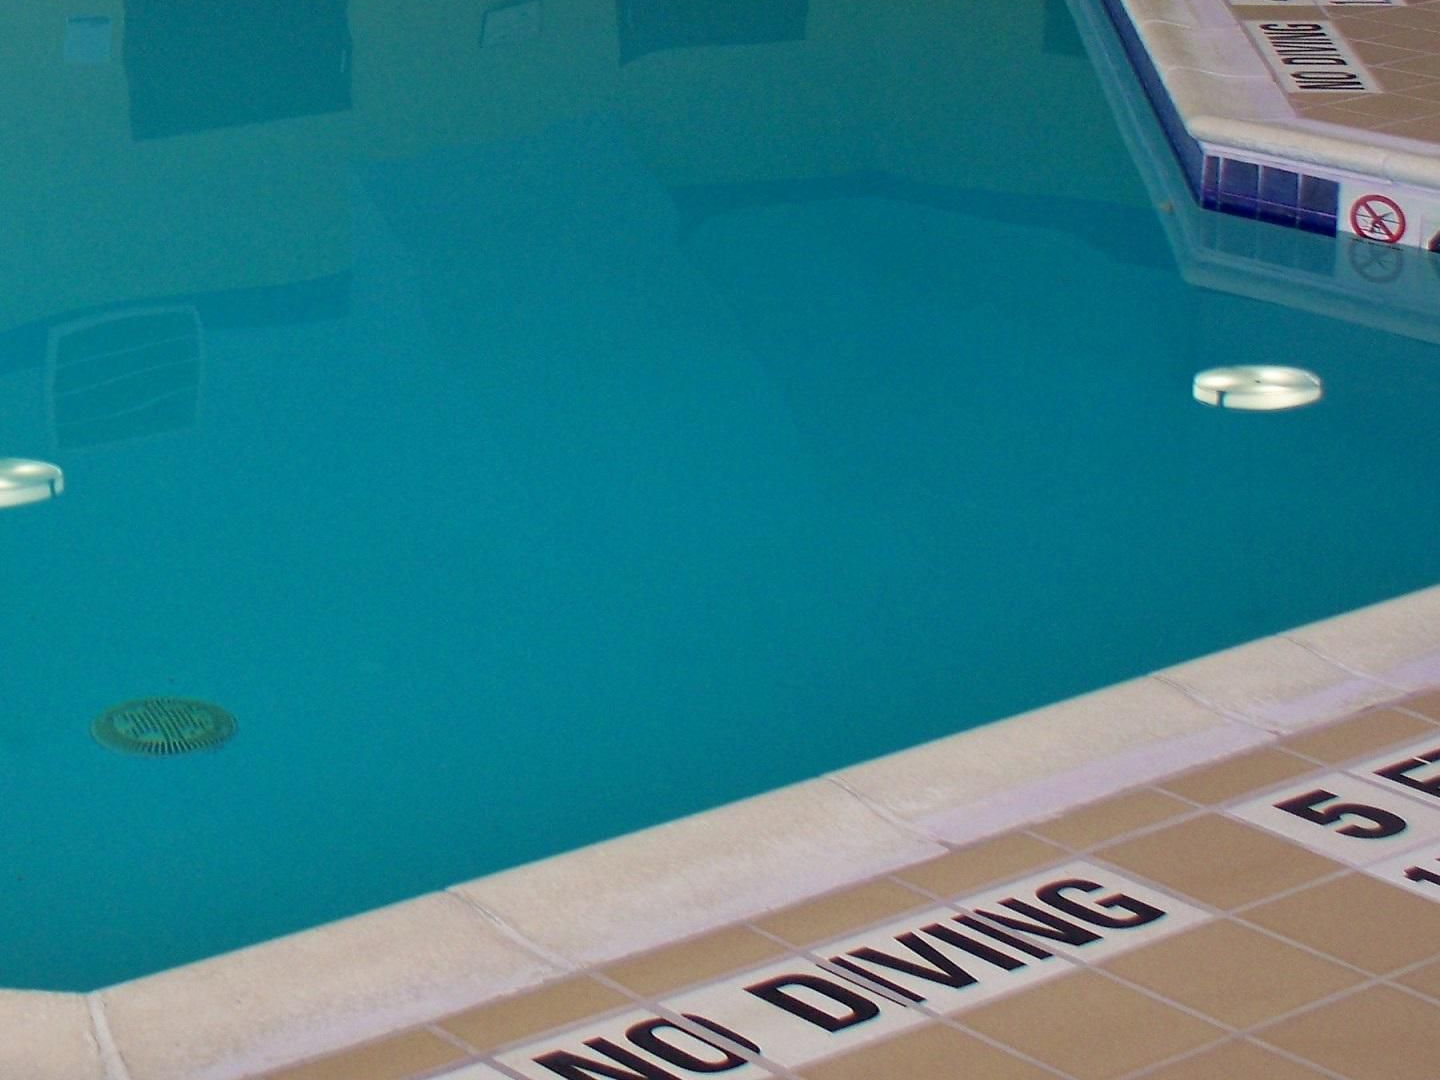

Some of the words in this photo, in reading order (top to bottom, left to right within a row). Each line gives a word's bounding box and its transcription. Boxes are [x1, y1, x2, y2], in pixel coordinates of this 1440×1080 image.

[1258, 23, 1349, 66] DIVING
[1289, 71, 1366, 91] NO
[532, 1013, 762, 1080] NO
[742, 877, 1168, 1034] DIVING
